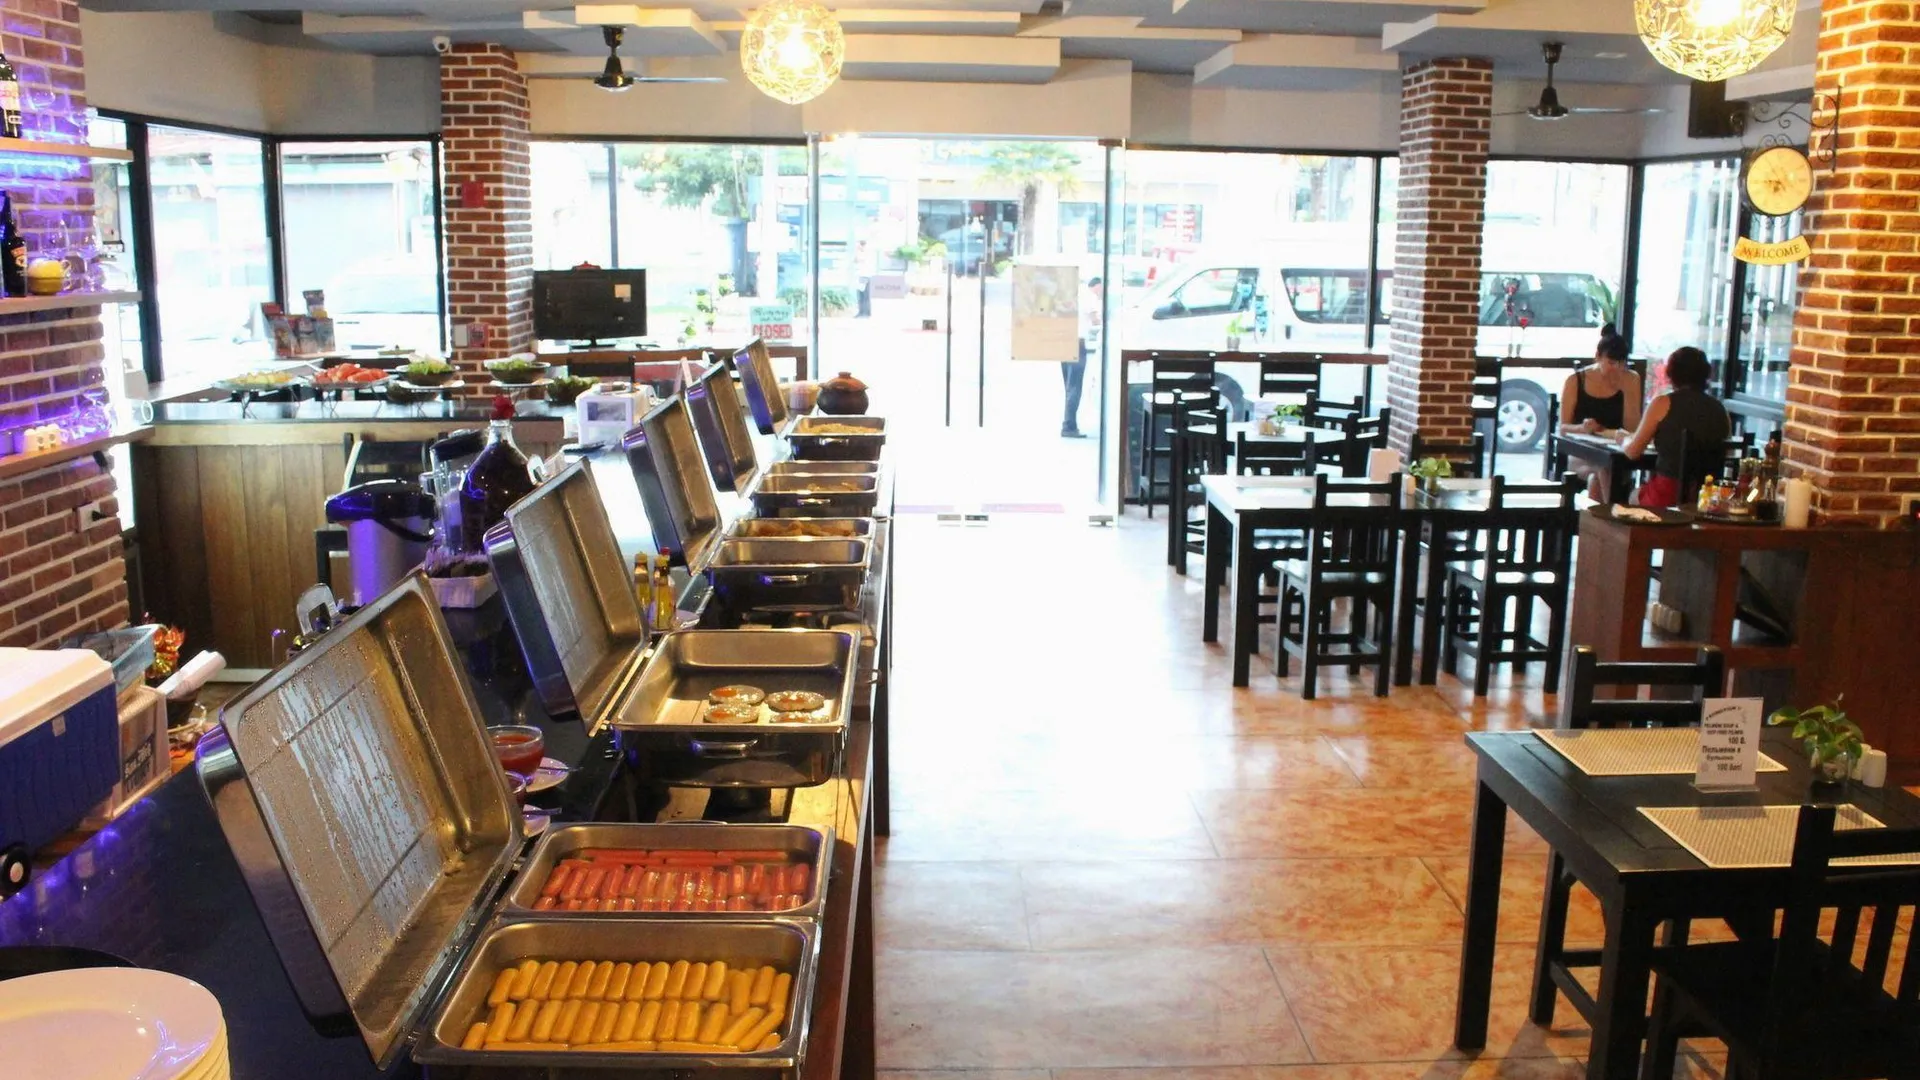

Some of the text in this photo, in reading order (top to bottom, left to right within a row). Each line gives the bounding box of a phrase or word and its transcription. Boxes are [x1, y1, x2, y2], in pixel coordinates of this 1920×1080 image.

[1741, 244, 1802, 259] WELCOME
[752, 324, 793, 339] CLOSED
[1717, 763, 1728, 771] 100
